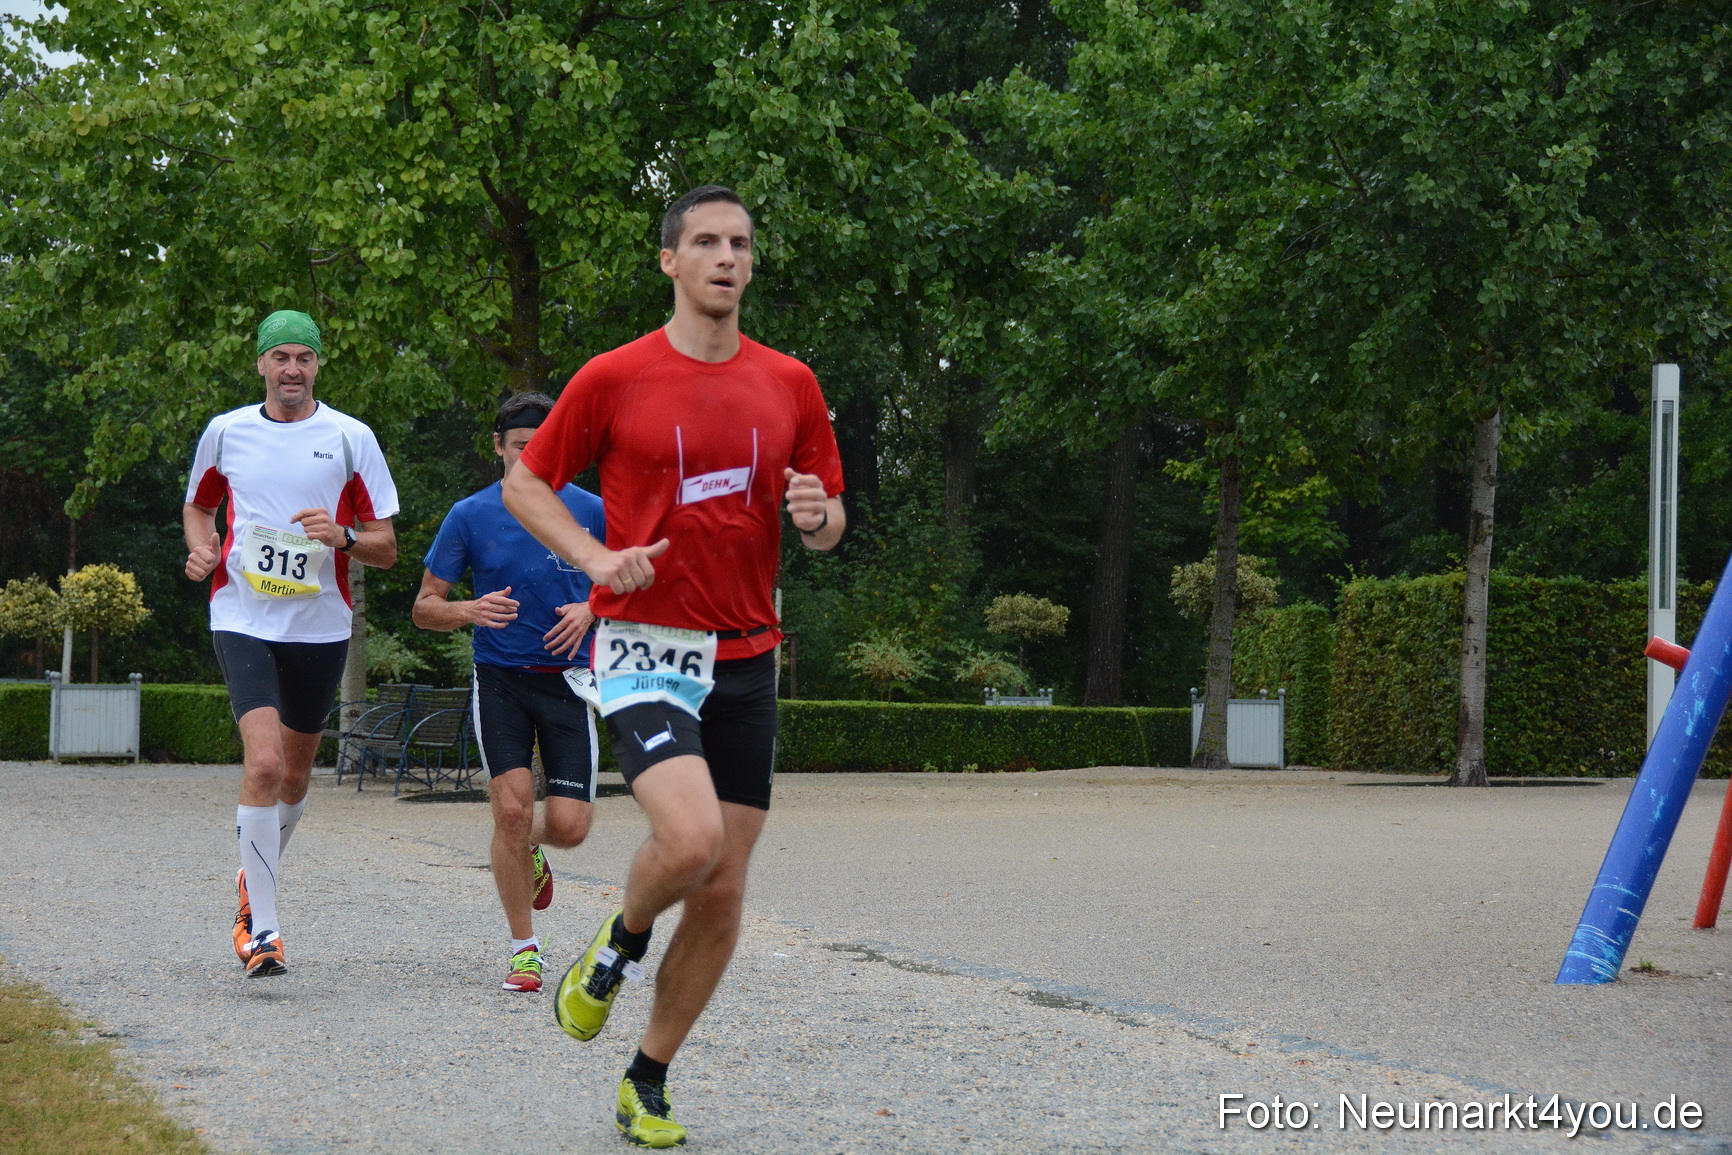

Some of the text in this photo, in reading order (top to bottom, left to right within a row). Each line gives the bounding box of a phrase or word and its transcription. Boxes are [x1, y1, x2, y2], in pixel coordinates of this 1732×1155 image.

[314, 451, 333, 459] Martin
[702, 478, 730, 491] DEHN
[258, 545, 308, 580] 313
[260, 580, 296, 595] Martin
[609, 638, 703, 677] 2346
[632, 676, 680, 692] Jürgen
